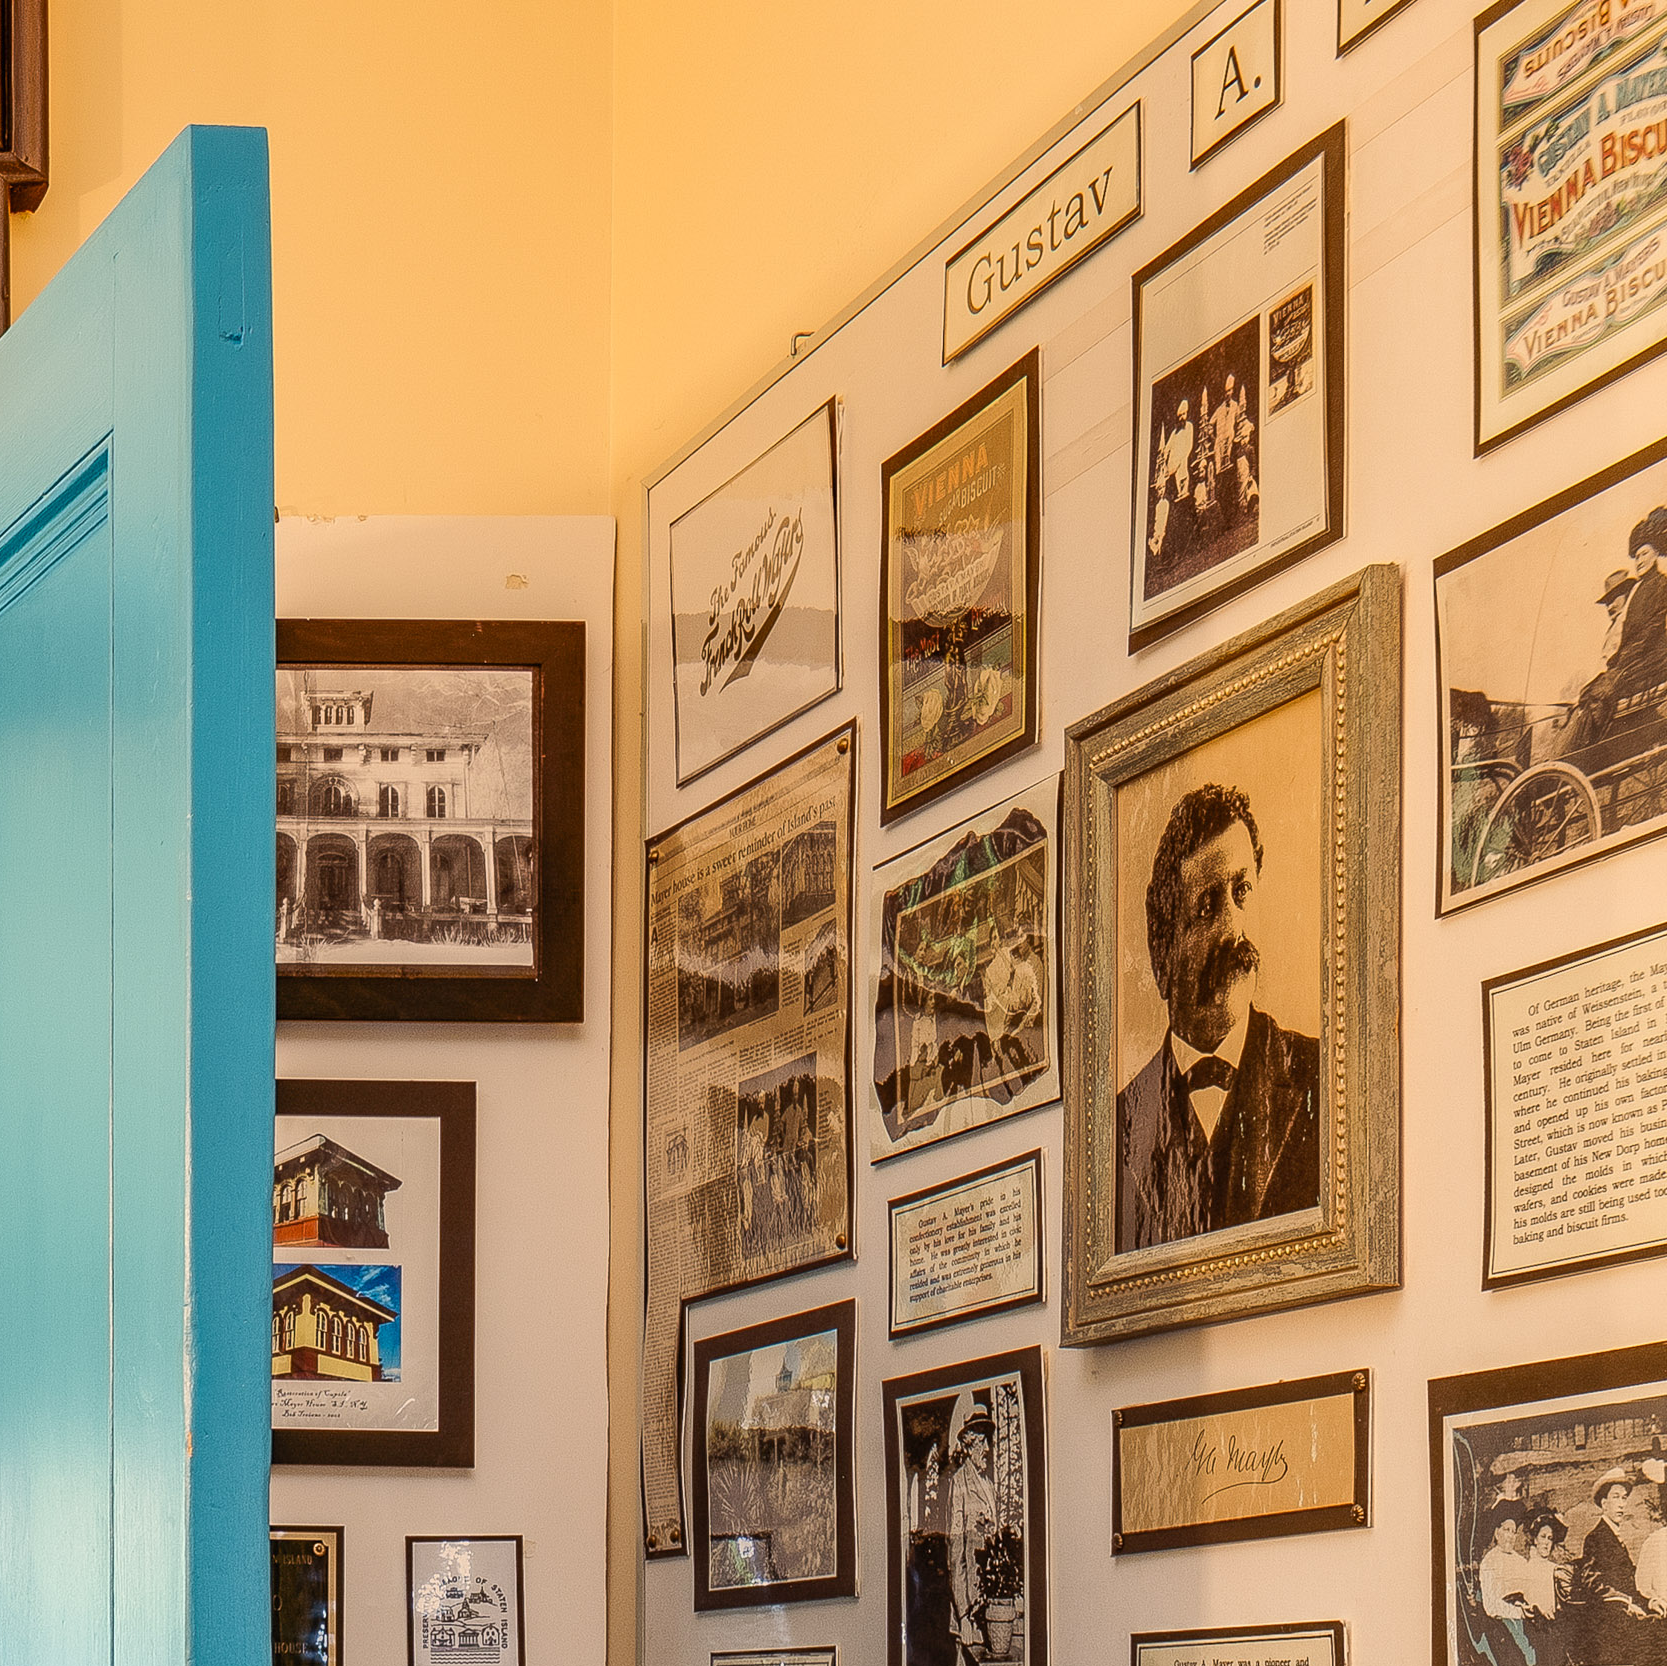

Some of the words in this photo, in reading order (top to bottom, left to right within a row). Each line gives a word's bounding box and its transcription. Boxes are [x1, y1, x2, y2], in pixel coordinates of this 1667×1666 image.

[966, 166, 1113, 315] Gustav
[1215, 46, 1263, 121] A.
[1512, 159, 1597, 250] VIENNA
[1523, 302, 1598, 360] VIENNA
[914, 442, 989, 518] VIENNA
[960, 464, 998, 509] BISCUIT
[709, 585, 729, 626] The
[730, 507, 776, 592] Famous
[672, 872, 696, 895] house
[697, 867, 705, 881] is
[776, 820, 787, 838] of
[787, 805, 819, 834] Island's
[1512, 1025, 1530, 1038] was
[1536, 1015, 1563, 1030] native
[1568, 1006, 1578, 1020] of
[1582, 987, 1645, 1014] Weissenstein,
[1651, 984, 1657, 993] a
[1528, 1003, 1540, 1016] Of
[1544, 992, 1580, 1011] German
[1585, 979, 1624, 998] heritage,
[1629, 970, 1645, 983] the
[1513, 1041, 1531, 1054] Ulm
[1535, 1027, 1579, 1047] Germany.
[1585, 1015, 1611, 1031] Being
[1615, 1010, 1629, 1022] the
[1632, 1004, 1652, 1017] first
[1655, 996, 1665, 1009] of
[1513, 1060, 1522, 1070] to
[1528, 1050, 1552, 1065] come
[1559, 1045, 1568, 1057] to
[1574, 1034, 1604, 1051] Staten
[1611, 1021, 1640, 1040] Island
[1647, 1018, 1657, 1030] in
[1513, 1070, 1541, 1086] Mayer
[1549, 1056, 1582, 1075] resided
[1591, 1048, 1612, 1063] here
[1620, 1041, 1634, 1054] for
[1513, 1084, 1551, 1102] century.
[1559, 1077, 1571, 1089] He
[1575, 1062, 1618, 1084] originally
[1621, 1052, 1653, 1071] settled
[1657, 1048, 1667, 1061] in
[1513, 1103, 1541, 1118] where
[1546, 1098, 1557, 1109] he
[1563, 1083, 1609, 1104] continued
[1615, 1078, 1630, 1090] his
[1635, 1067, 1667, 1084] baking
[1513, 1120, 1531, 1134] and
[1536, 1109, 1569, 1129] opened
[1575, 1107, 1589, 1118] up
[1594, 1100, 1609, 1112] his
[1615, 1094, 1635, 1106] own
[1514, 1135, 1543, 1150] Street,
[1547, 1125, 1574, 1141] which
[1577, 1122, 1585, 1133] is
[1588, 1117, 1608, 1130] now
[1611, 1107, 1644, 1124] known
[1647, 1104, 1657, 1115] as
[1514, 1152, 1541, 1166] Later,
[1545, 1141, 1578, 1157] Gustav
[1583, 1130, 1614, 1148] moved
[1619, 1127, 1635, 1139] his
[1514, 1163, 1558, 1181] basement
[1561, 1157, 1571, 1170] of
[1574, 1155, 1588, 1167] his
[1592, 1150, 1612, 1162] New
[1616, 1142, 1640, 1157] Dorp
[1644, 1136, 1667, 1150] home
[1514, 1179, 1554, 1198] designed
[1562, 1175, 1577, 1186] the
[1585, 1165, 1614, 1180] molds
[1622, 1160, 1632, 1172] in
[1641, 1151, 1667, 1167] which
[918, 1216, 937, 1229] Gustav
[980, 1196, 994, 1211] pride
[1000, 1193, 1006, 1201] in
[1012, 1187, 1021, 1197] his
[1513, 1218, 1527, 1229] his
[1530, 1211, 1558, 1226] molds
[1560, 1208, 1576, 1219] are
[1578, 1201, 1595, 1215] still
[1599, 1194, 1625, 1210] being
[1627, 1188, 1650, 1203] used
[1514, 1199, 1546, 1213] wafers,
[1551, 1191, 1568, 1205] and
[1572, 1184, 1608, 1200] cookies
[1612, 1178, 1635, 1190] were
[1639, 1170, 1667, 1184] made
[1513, 1230, 1545, 1245] baking
[1546, 1224, 1564, 1238] and
[1567, 1218, 1599, 1234] biscuit
[1601, 1213, 1629, 1227] firms.
[283, 1554, 313, 1565] ISLAND
[475, 1577, 488, 1585] OF
[490, 1584, 508, 1613] STATEN
[500, 1619, 508, 1649] ISLAND
[274, 1642, 308, 1654] HOUSE
[1295, 1656, 1309, 1666] and
